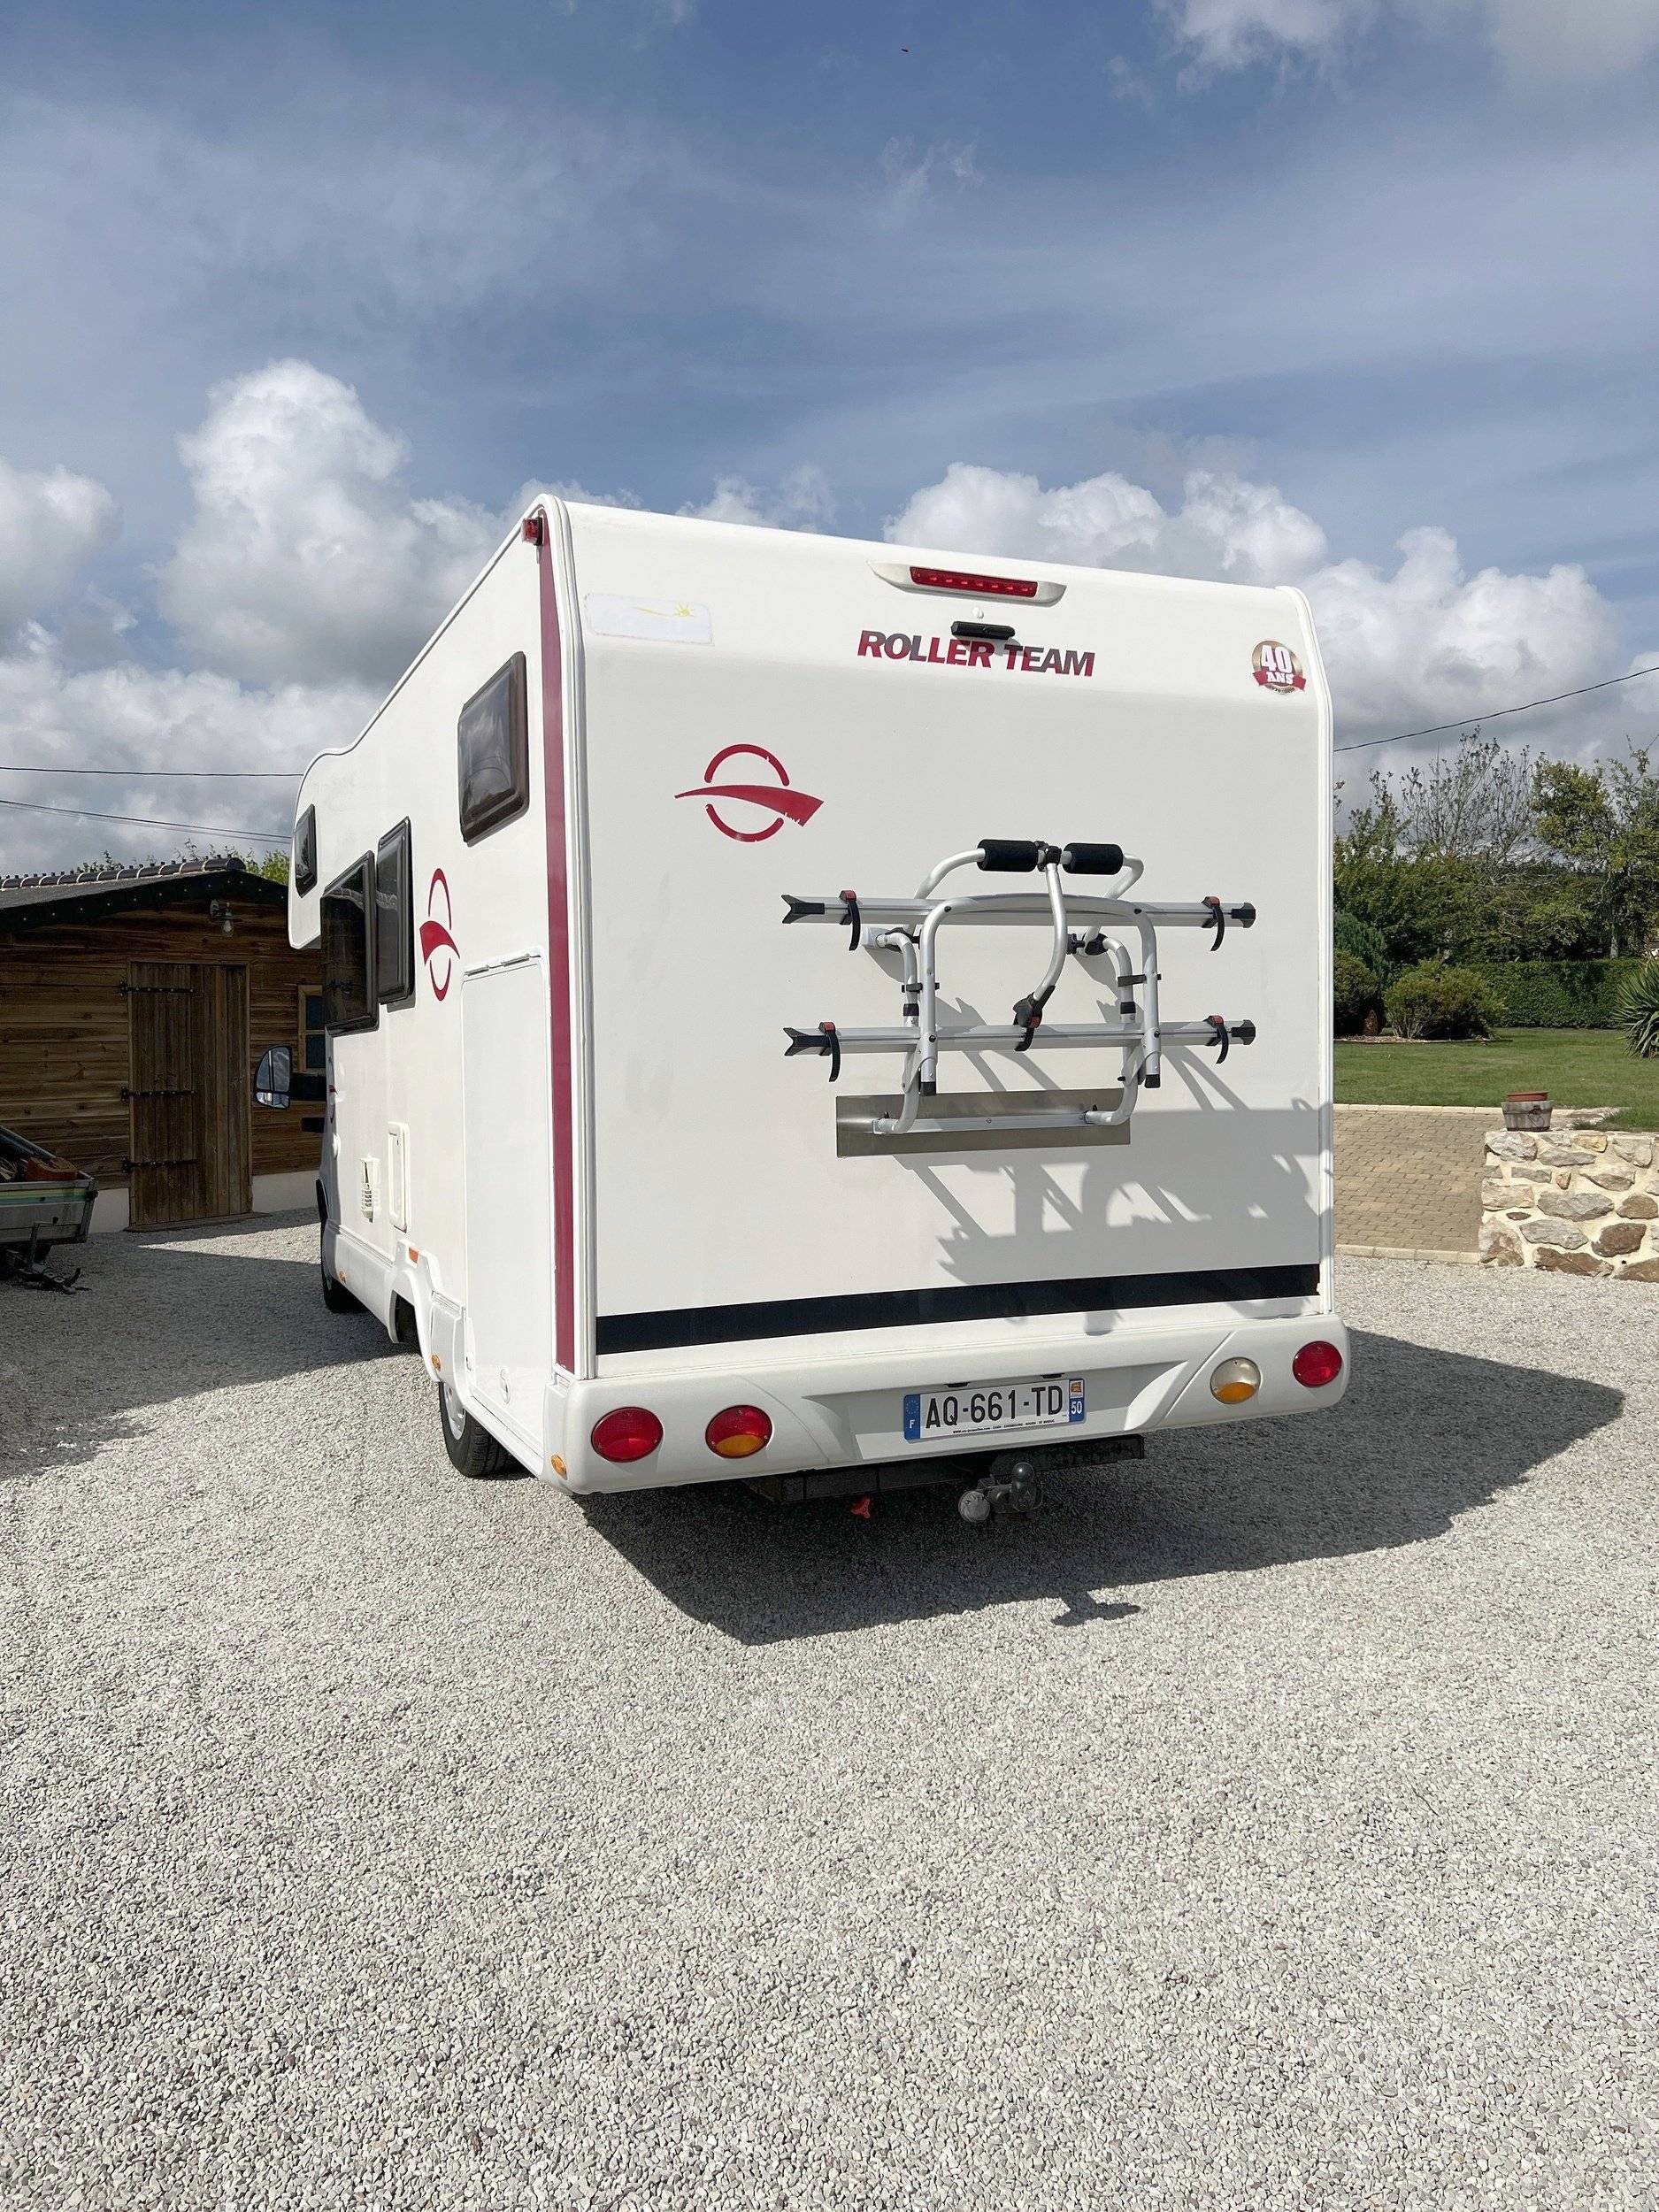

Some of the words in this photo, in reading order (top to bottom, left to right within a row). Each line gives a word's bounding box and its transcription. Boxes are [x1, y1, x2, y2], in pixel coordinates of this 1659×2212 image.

[856, 629, 995, 670] ROLLER
[1003, 643, 1096, 678] TEAM
[1261, 644, 1293, 674] 40
[1265, 671, 1294, 685] ANS
[909, 1419, 916, 1429] F
[925, 1385, 1064, 1429] AQ-661-TD
[1071, 1401, 1083, 1415] 50
